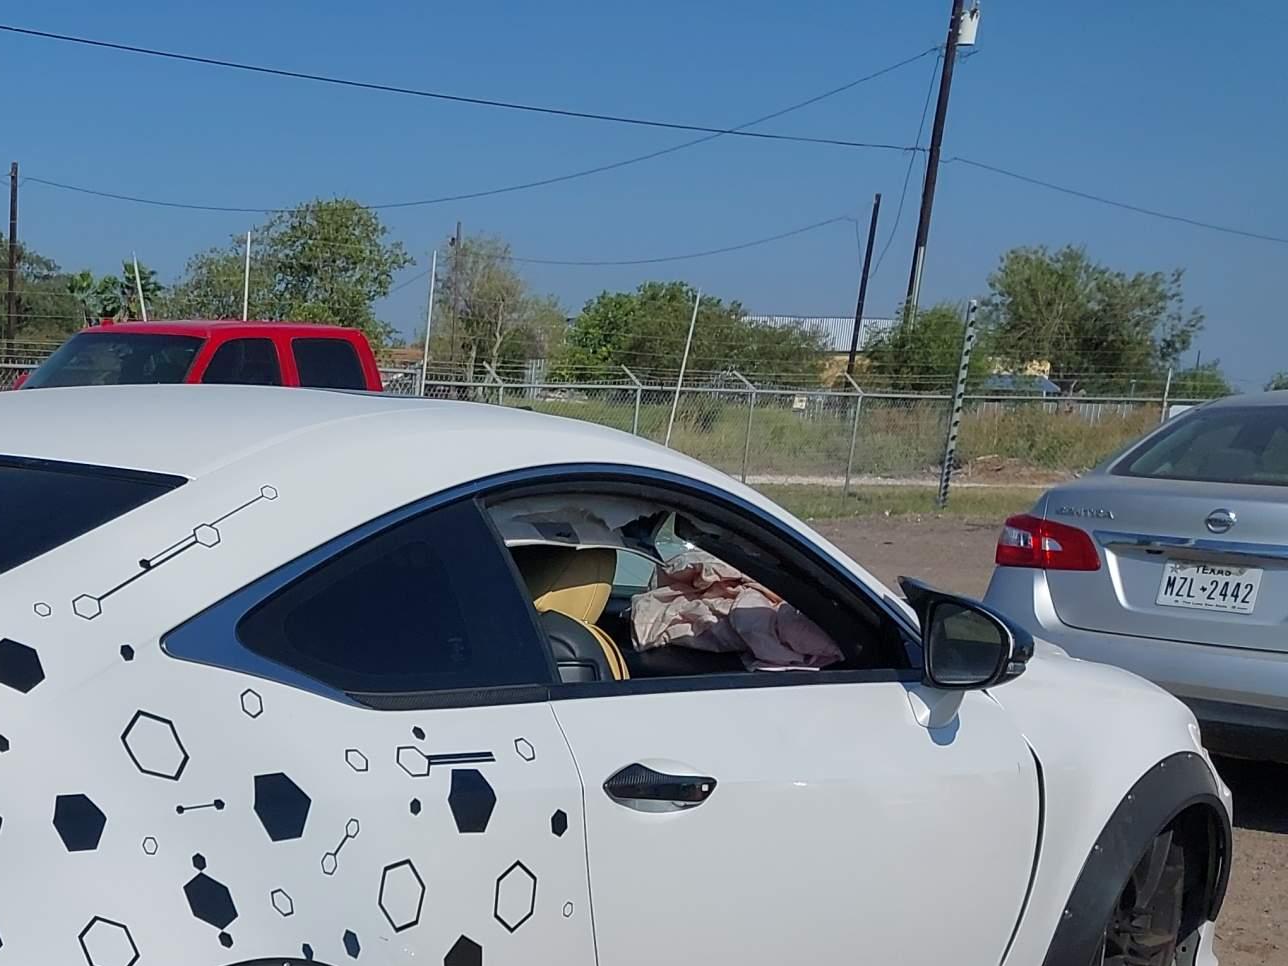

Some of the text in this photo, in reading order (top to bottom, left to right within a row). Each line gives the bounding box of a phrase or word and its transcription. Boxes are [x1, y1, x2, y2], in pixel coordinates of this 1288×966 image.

[1195, 565, 1232, 577] TEXAS
[1164, 575, 1253, 604] MZL 2442
